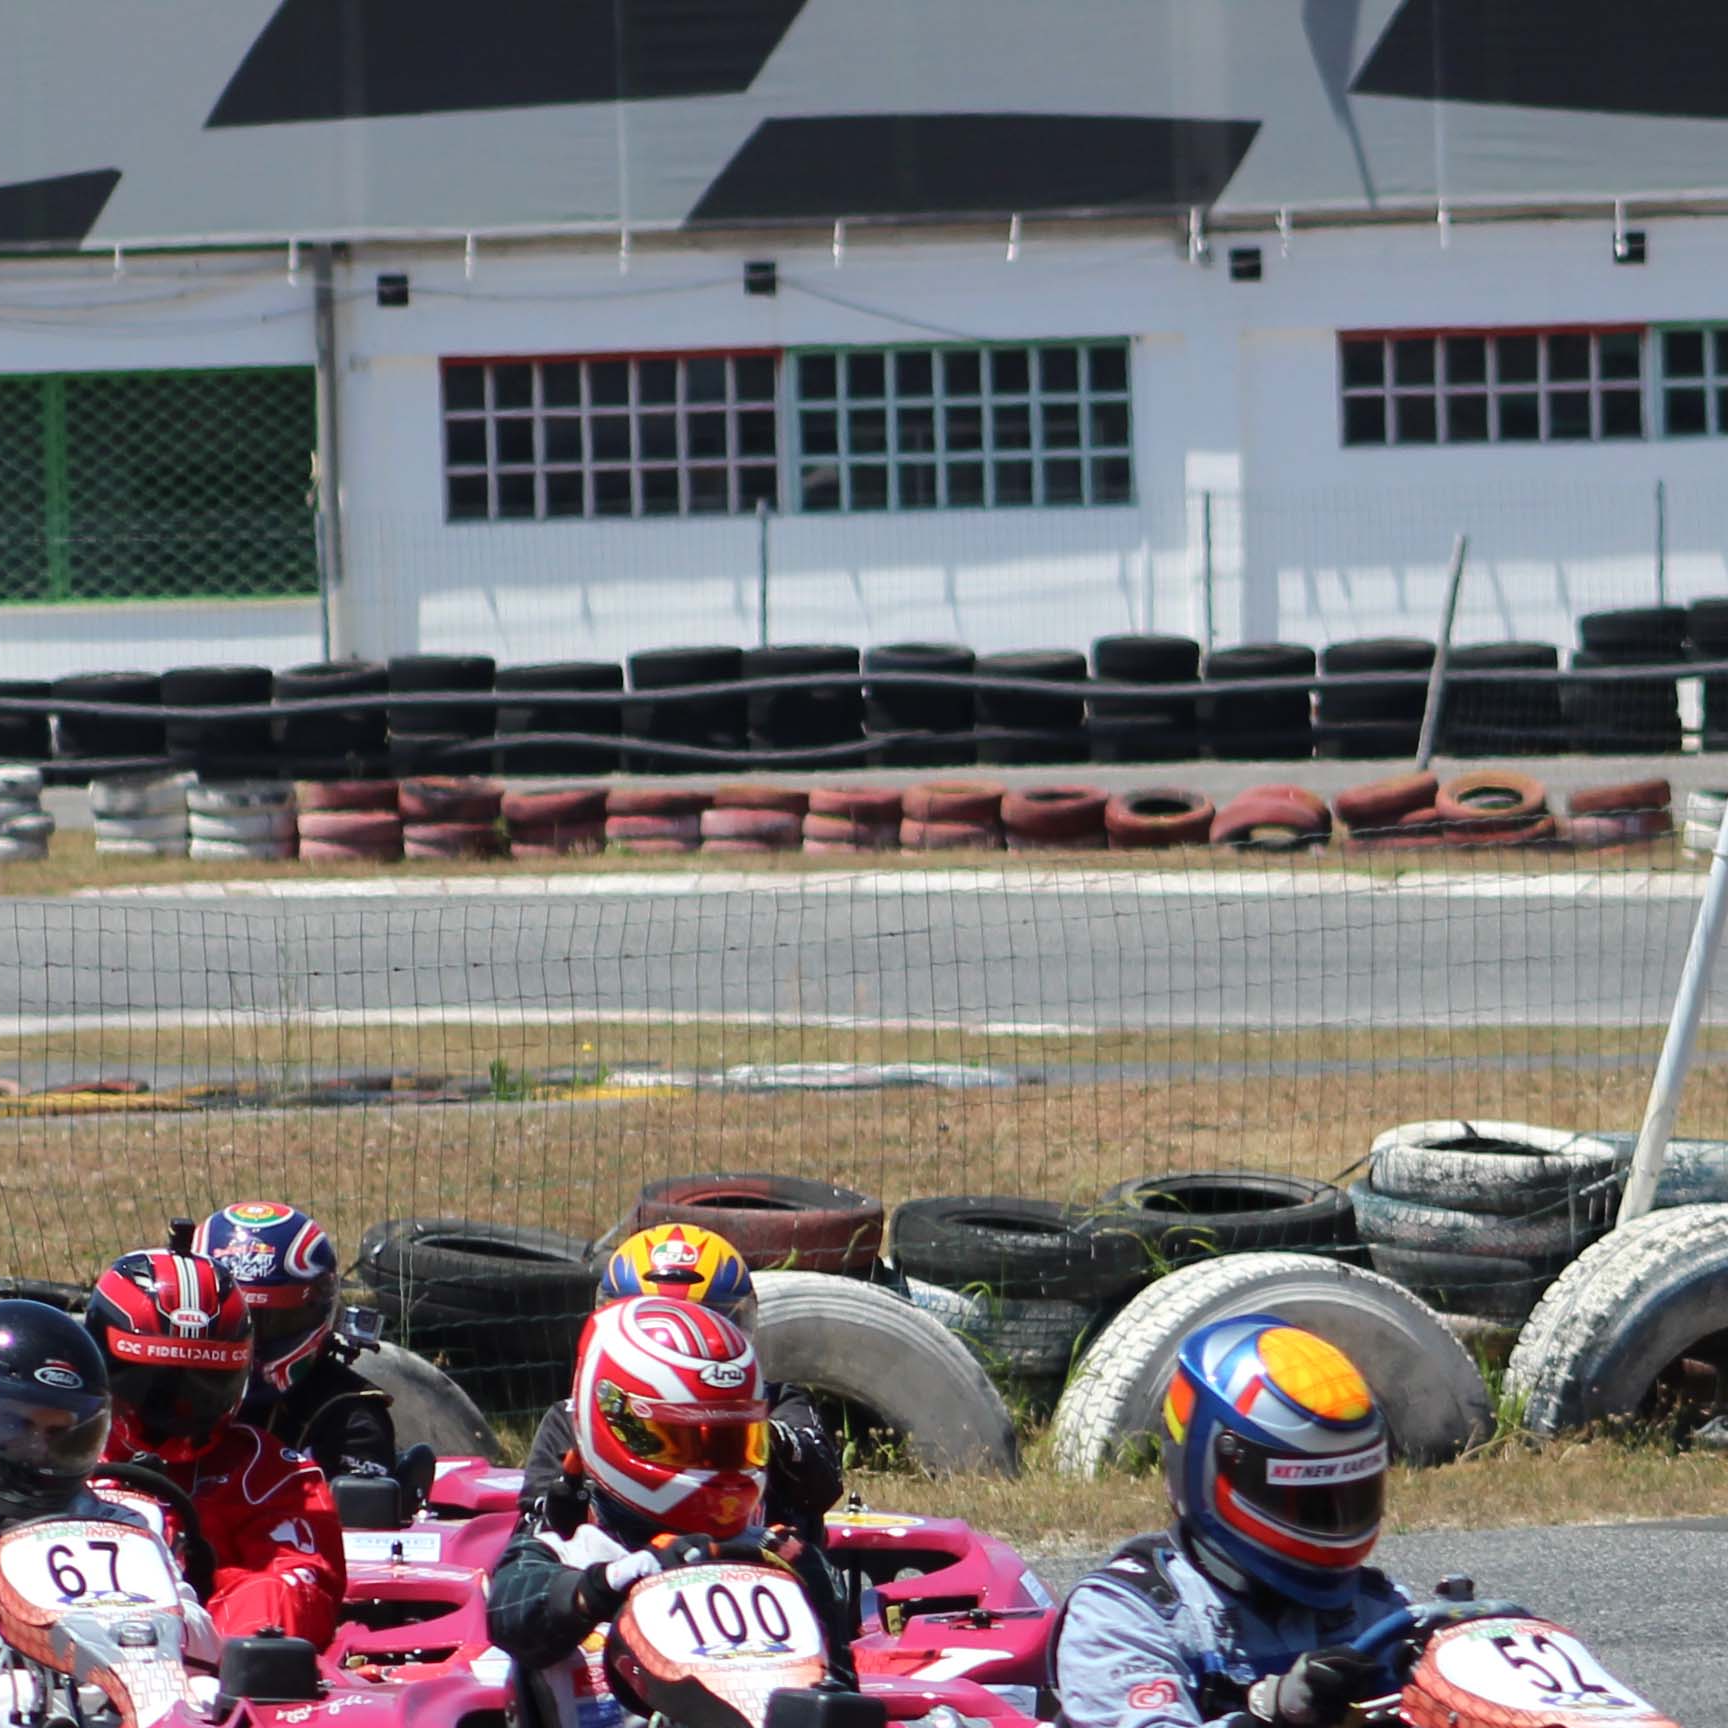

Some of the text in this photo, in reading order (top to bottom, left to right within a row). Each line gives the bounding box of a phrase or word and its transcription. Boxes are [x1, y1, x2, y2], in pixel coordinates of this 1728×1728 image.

[147, 1345, 226, 1362] FIDELIDADE
[46, 1541, 121, 1598] 67
[668, 1583, 791, 1646] 100
[1489, 1635, 1610, 1693] 52
